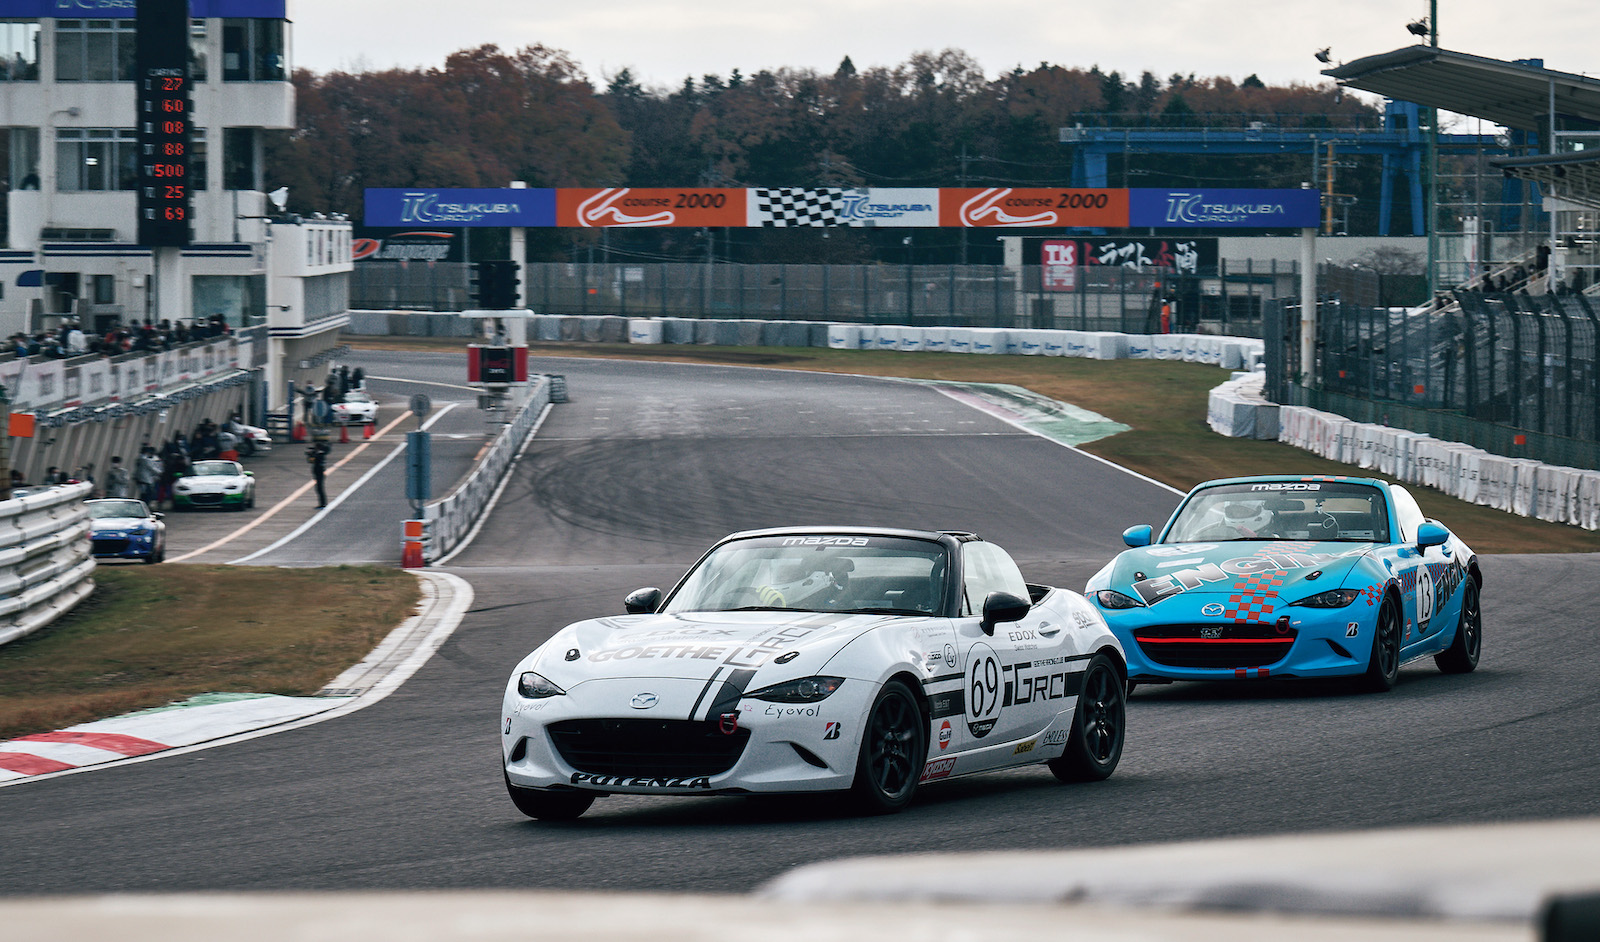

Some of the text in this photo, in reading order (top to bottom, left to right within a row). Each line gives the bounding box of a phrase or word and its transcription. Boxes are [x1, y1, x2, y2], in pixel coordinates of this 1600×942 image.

[162, 77, 183, 90] 27
[162, 99, 184, 112] 60
[155, 164, 184, 177] 500
[165, 186, 184, 198] 25
[623, 193, 727, 209] course 2000
[1005, 193, 1109, 209] course 2000
[165, 207, 184, 220] 69
[438, 203, 521, 213] TSUKUBA
[868, 204, 932, 212] TSUKUBA
[1202, 204, 1285, 214] TSUKUBA
[1419, 572, 1431, 618] 13
[1008, 630, 1037, 641] EDOX
[588, 645, 726, 662] GOETHE
[971, 656, 999, 718] 69
[1014, 660, 1064, 705] GRC
[570, 772, 711, 789] POTENZA
